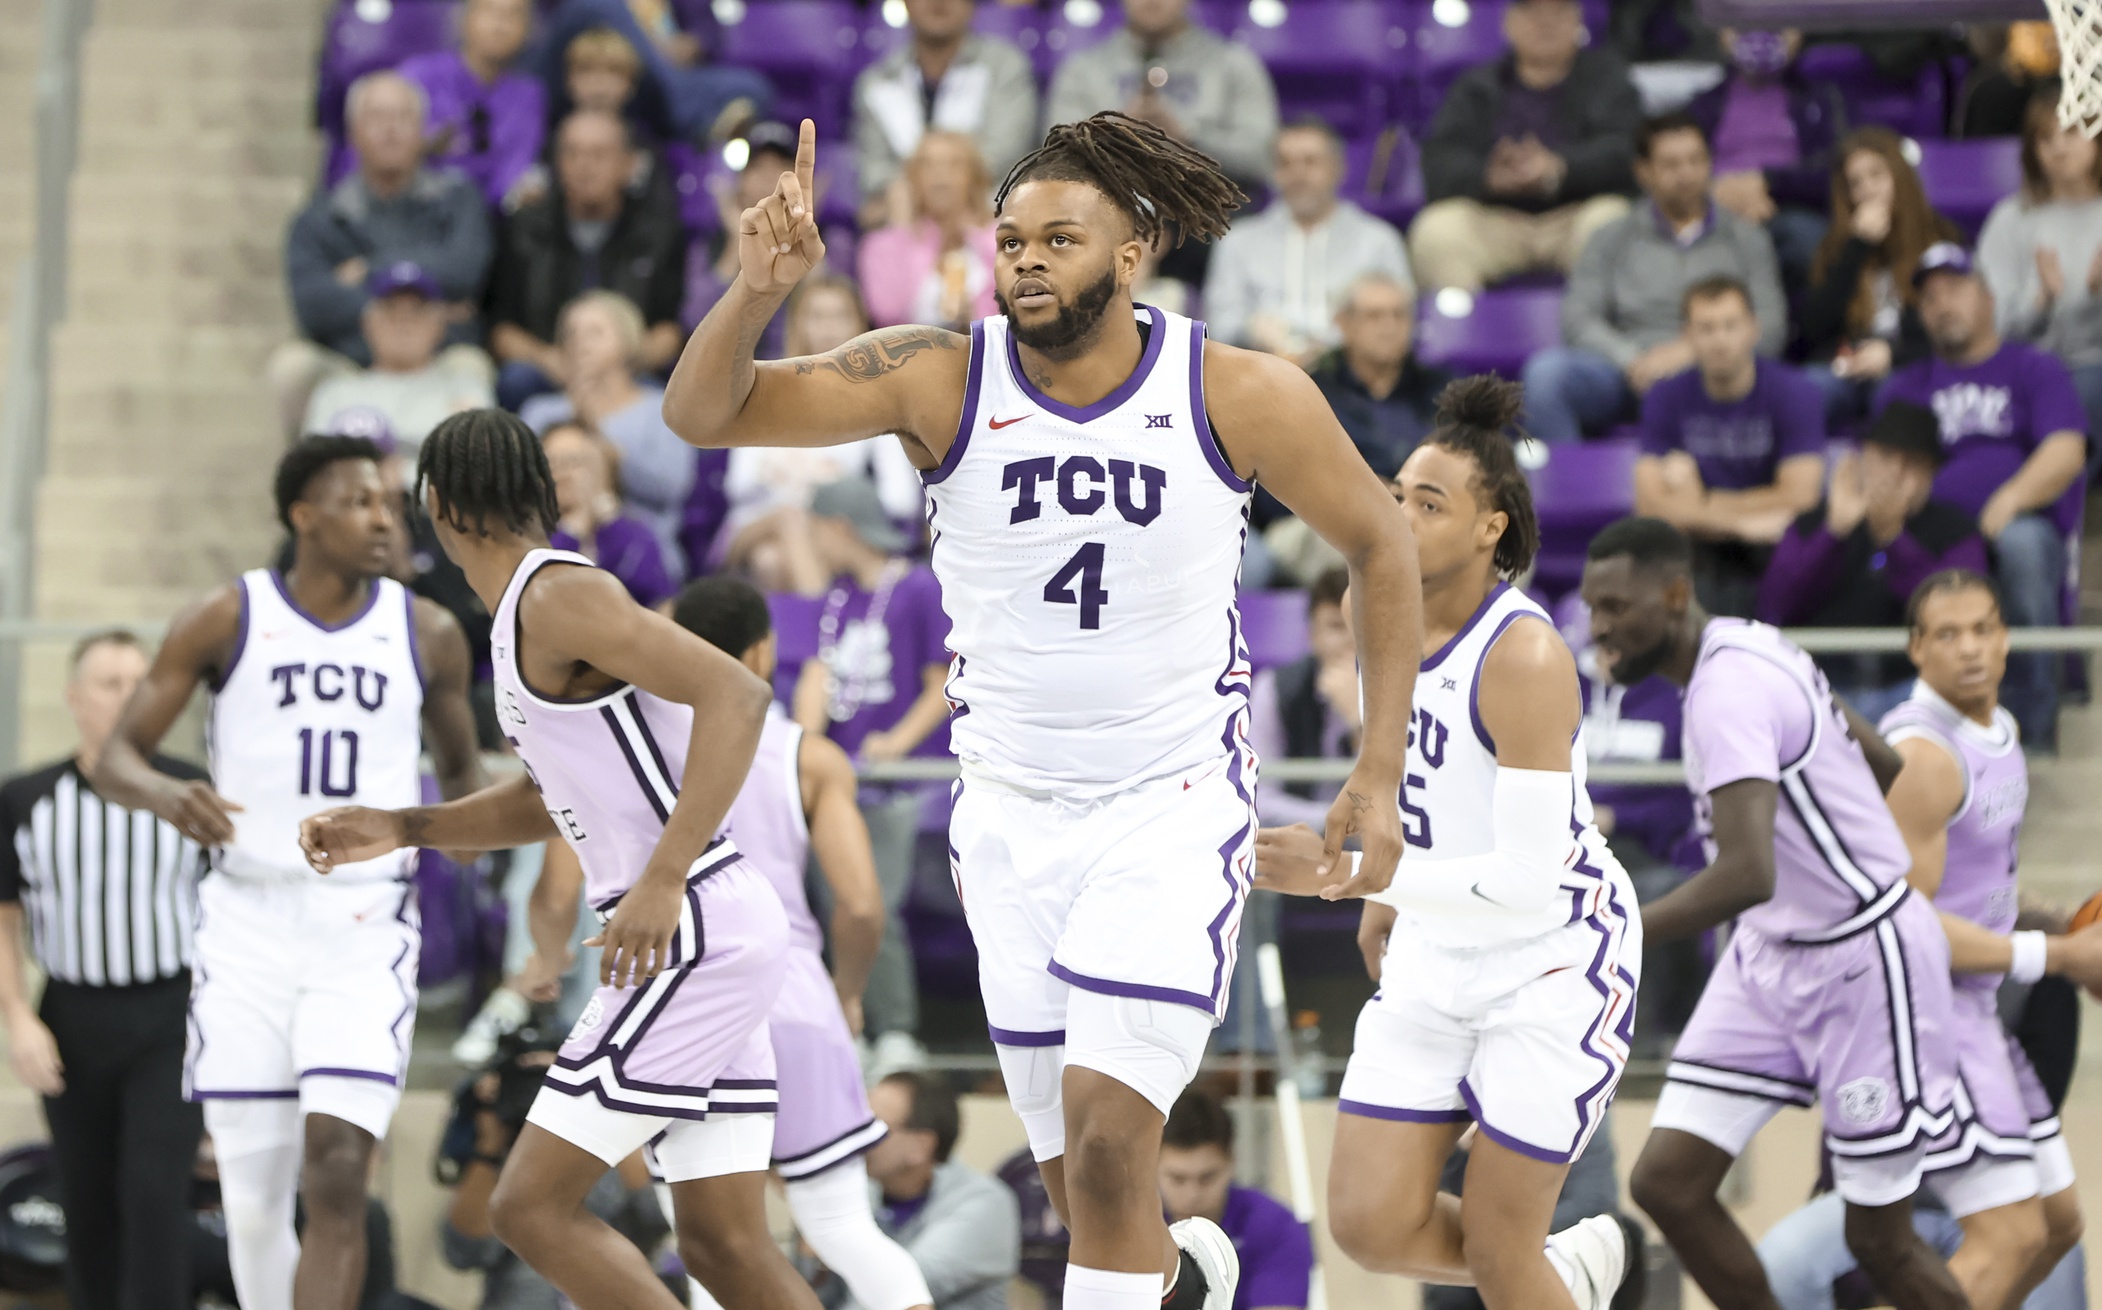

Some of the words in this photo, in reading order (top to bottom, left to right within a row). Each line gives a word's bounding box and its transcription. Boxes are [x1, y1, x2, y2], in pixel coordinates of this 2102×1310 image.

[1144, 413, 1174, 429] XII
[1001, 455, 1167, 528] TCU
[1043, 541, 1108, 630] 4
[271, 663, 389, 712] TCU
[299, 728, 359, 797] 10
[1398, 772, 1434, 850] 5
